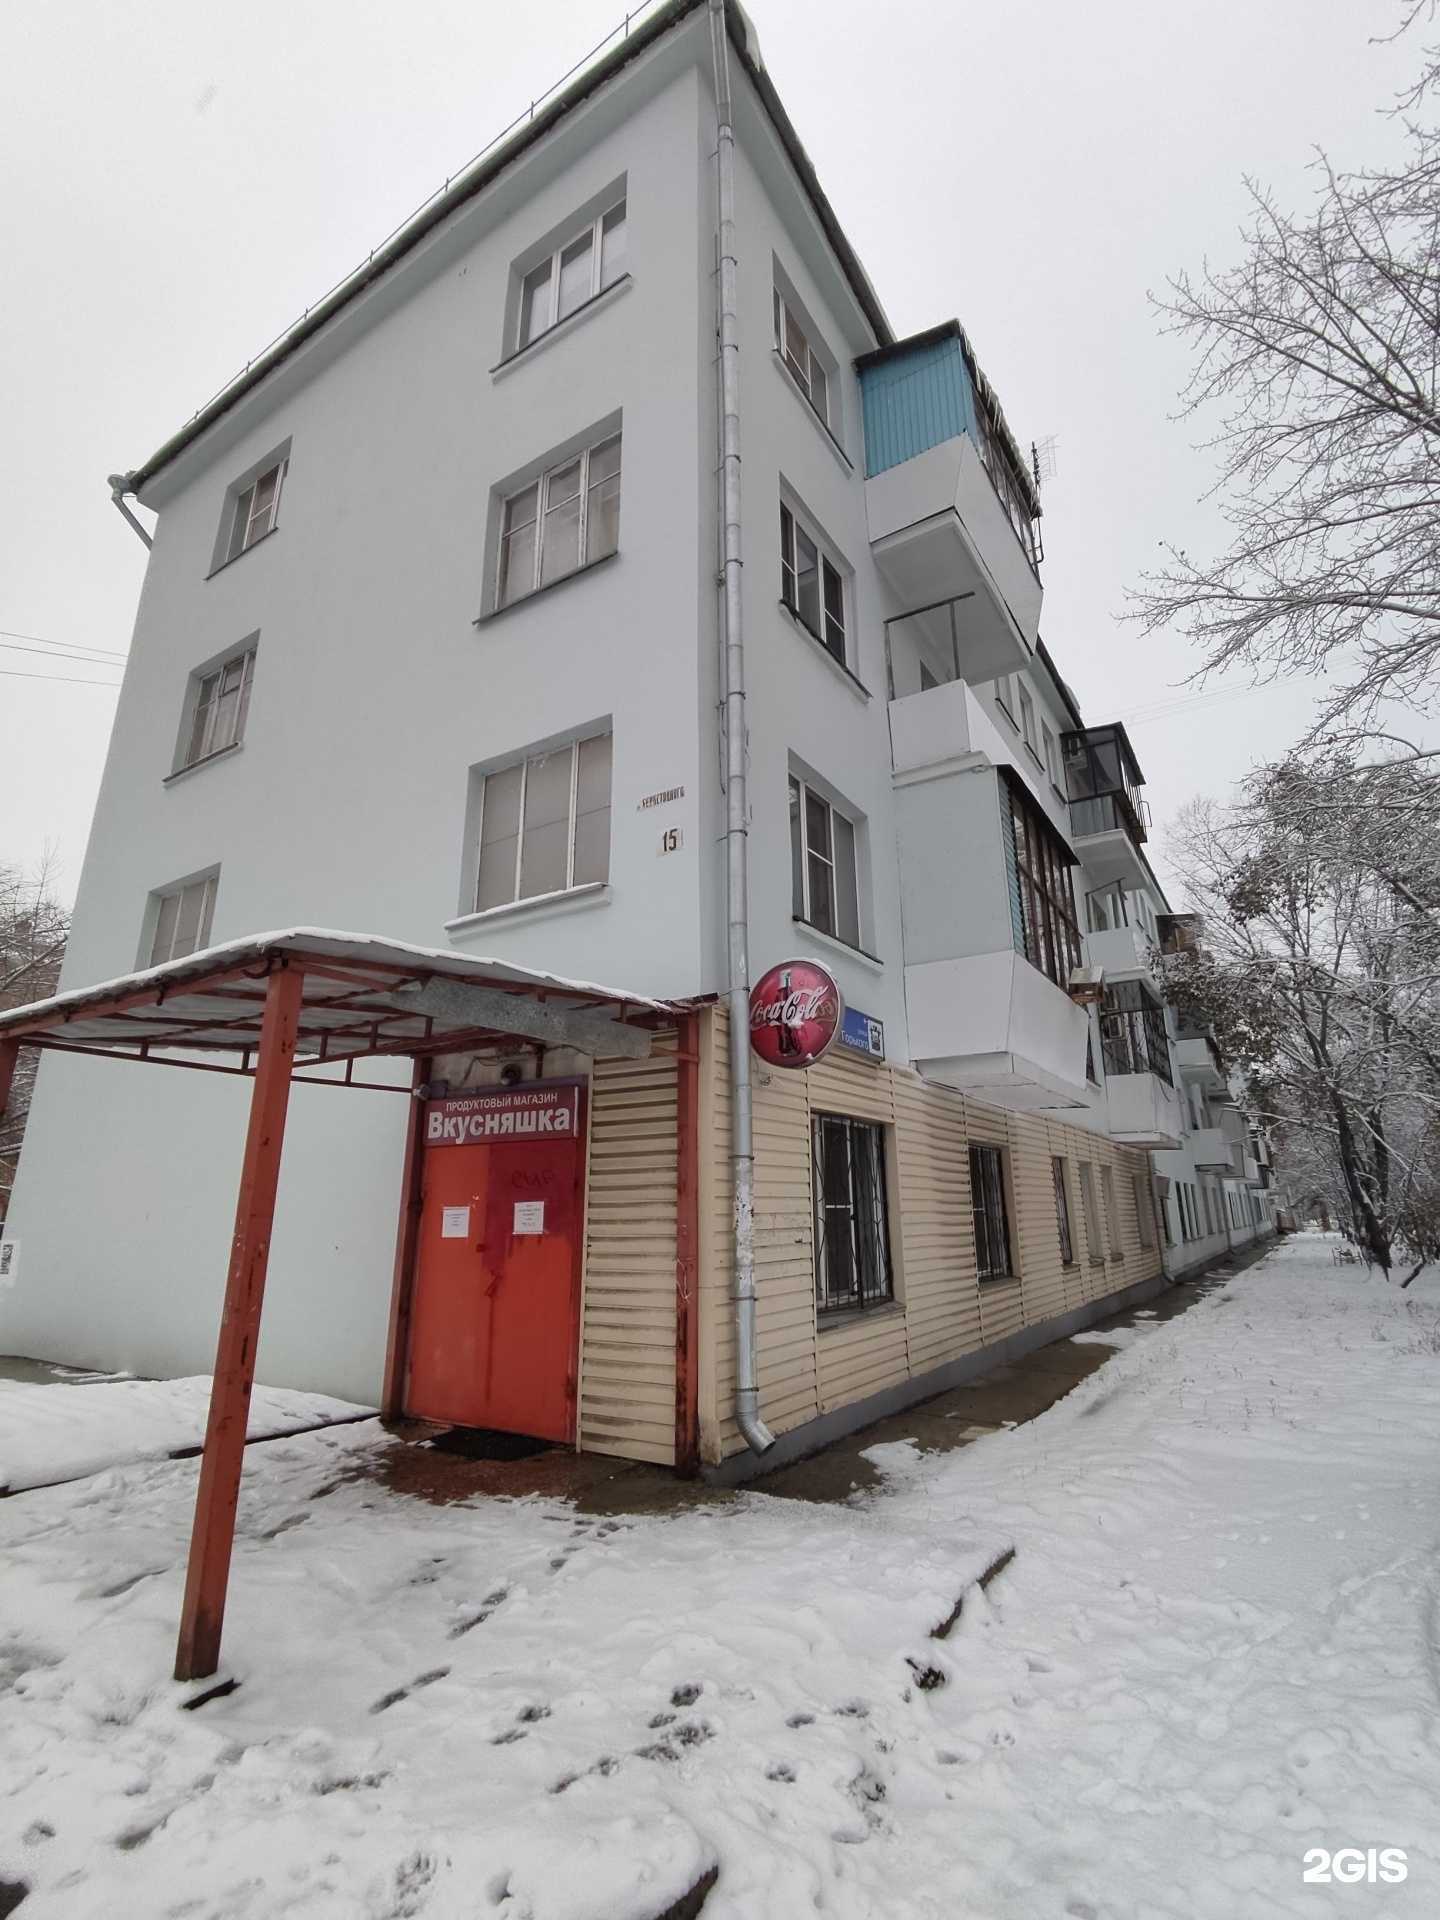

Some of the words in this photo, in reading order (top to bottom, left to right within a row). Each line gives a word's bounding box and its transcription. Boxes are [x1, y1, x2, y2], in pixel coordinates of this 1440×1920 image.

[663, 828, 678, 852] 15
[446, 1095, 512, 1112] ПРОДУКТОВЫЙ
[513, 1092, 558, 1106] МАГАЗИН
[427, 1107, 571, 1145] Вкусняшка
